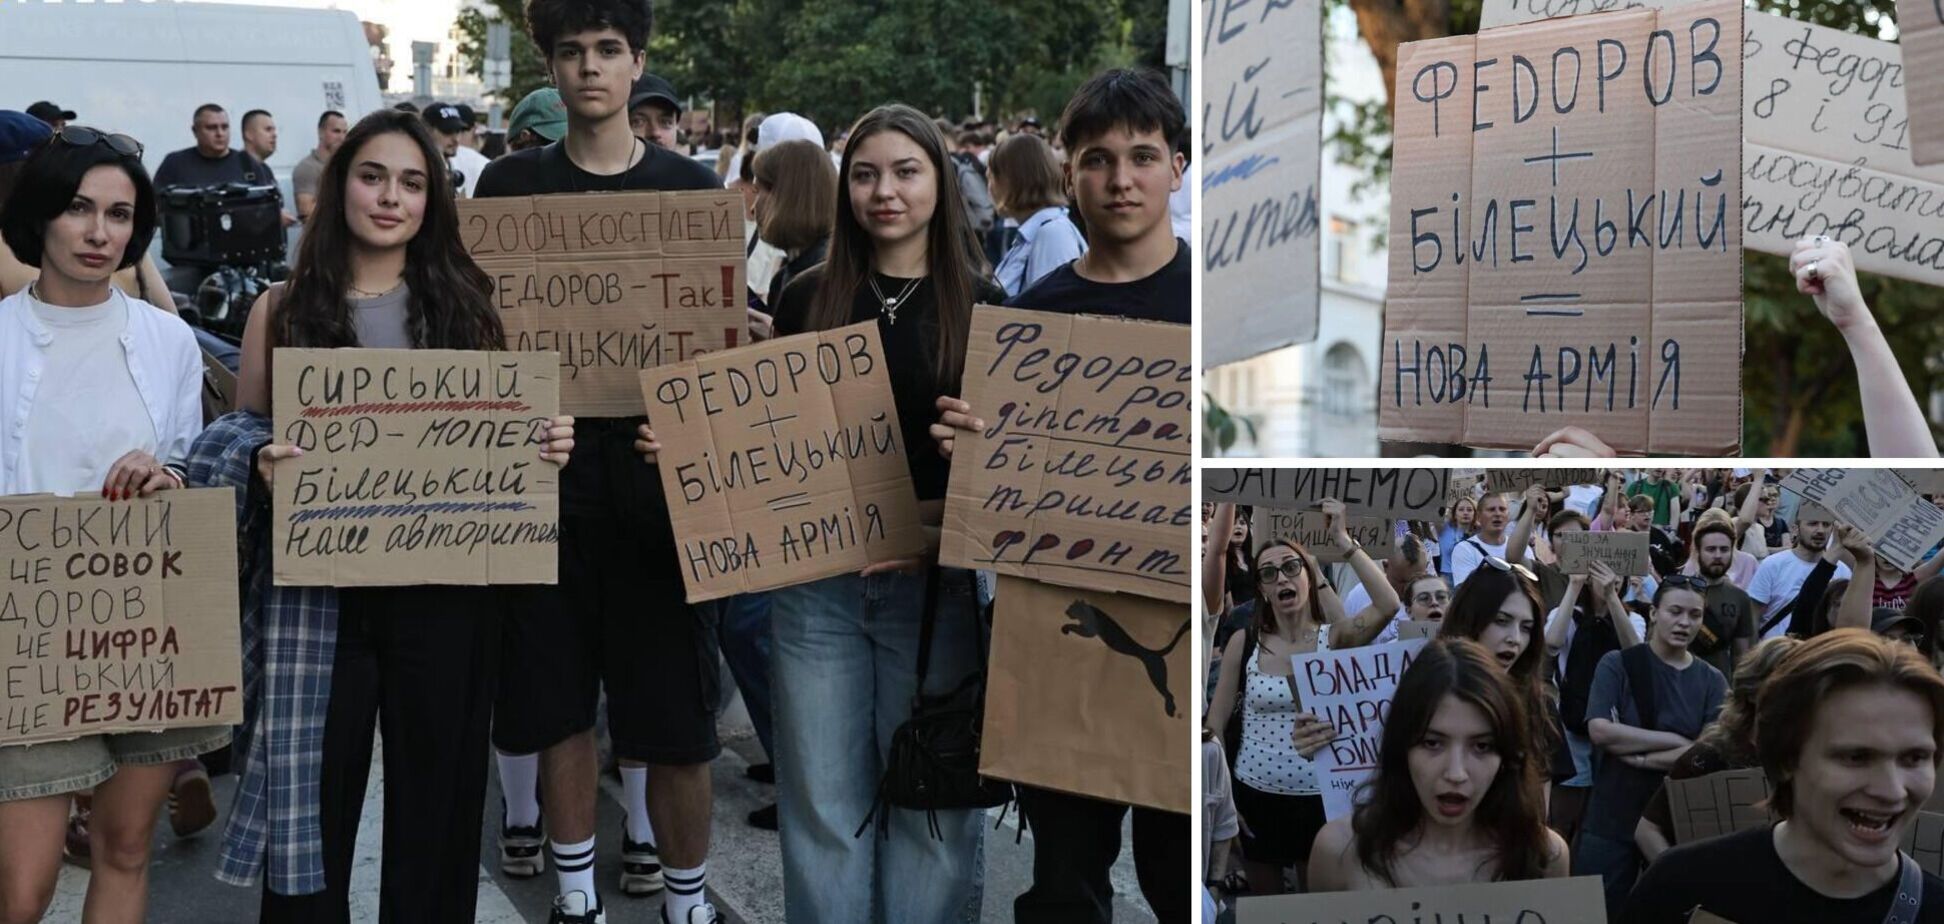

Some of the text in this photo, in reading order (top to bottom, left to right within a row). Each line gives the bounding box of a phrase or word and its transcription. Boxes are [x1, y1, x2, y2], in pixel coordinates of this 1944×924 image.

[469, 212, 567, 256] 2004
[1396, 337, 1492, 408] НОВА
[985, 402, 1191, 446] діпстра
[10, 550, 182, 584] ЦЕ СОВОК
[685, 532, 760, 582] НОВА
[17, 626, 179, 660] ЦЕ ЦИФРА
[63, 685, 236, 727] РЕЗУЛЬТАТ
